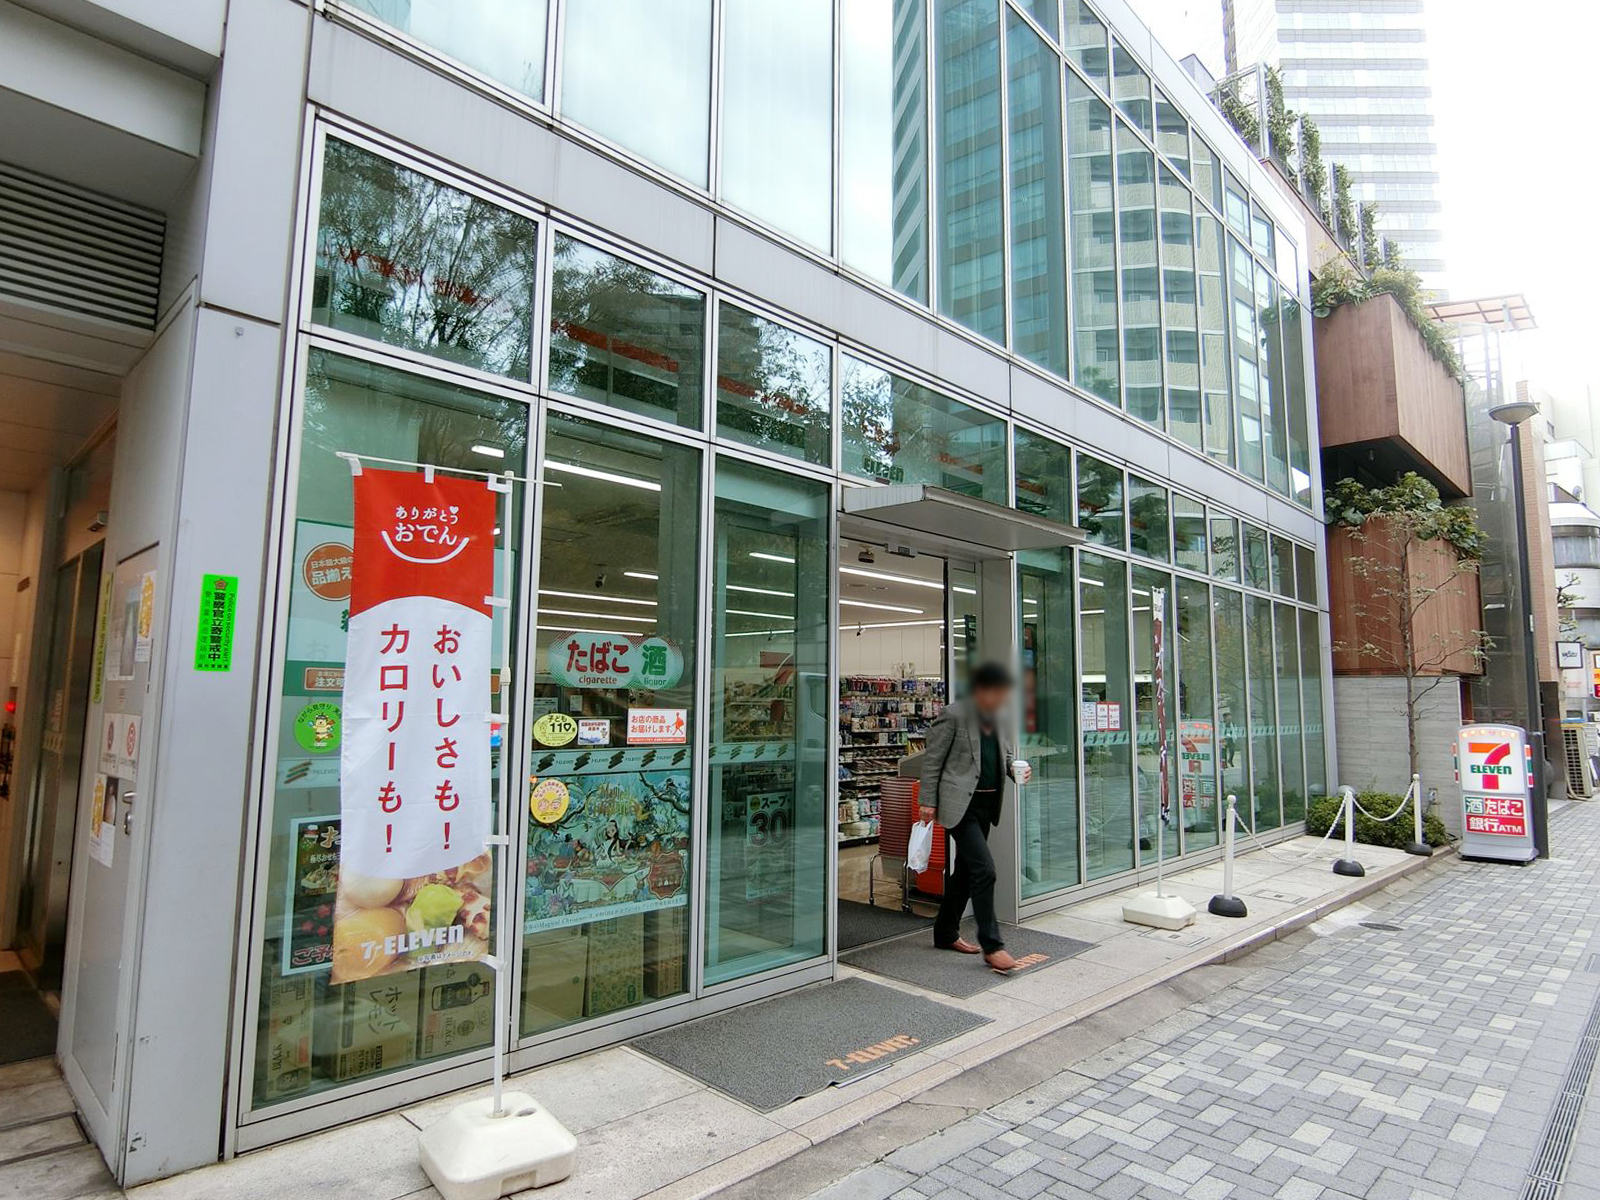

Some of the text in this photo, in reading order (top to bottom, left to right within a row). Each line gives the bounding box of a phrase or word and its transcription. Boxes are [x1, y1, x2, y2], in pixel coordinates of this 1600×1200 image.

[395, 505, 459, 525] ありがとう
[395, 522, 458, 546] おでん
[567, 640, 667, 675] たばこ 酒
[578, 675, 666, 687] cigarette liquor
[547, 715, 568, 723] 子ども
[631, 715, 667, 724] お店の商品
[1466, 797, 1523, 816] 酒 たばこ
[384, 987, 402, 1031] ホット
